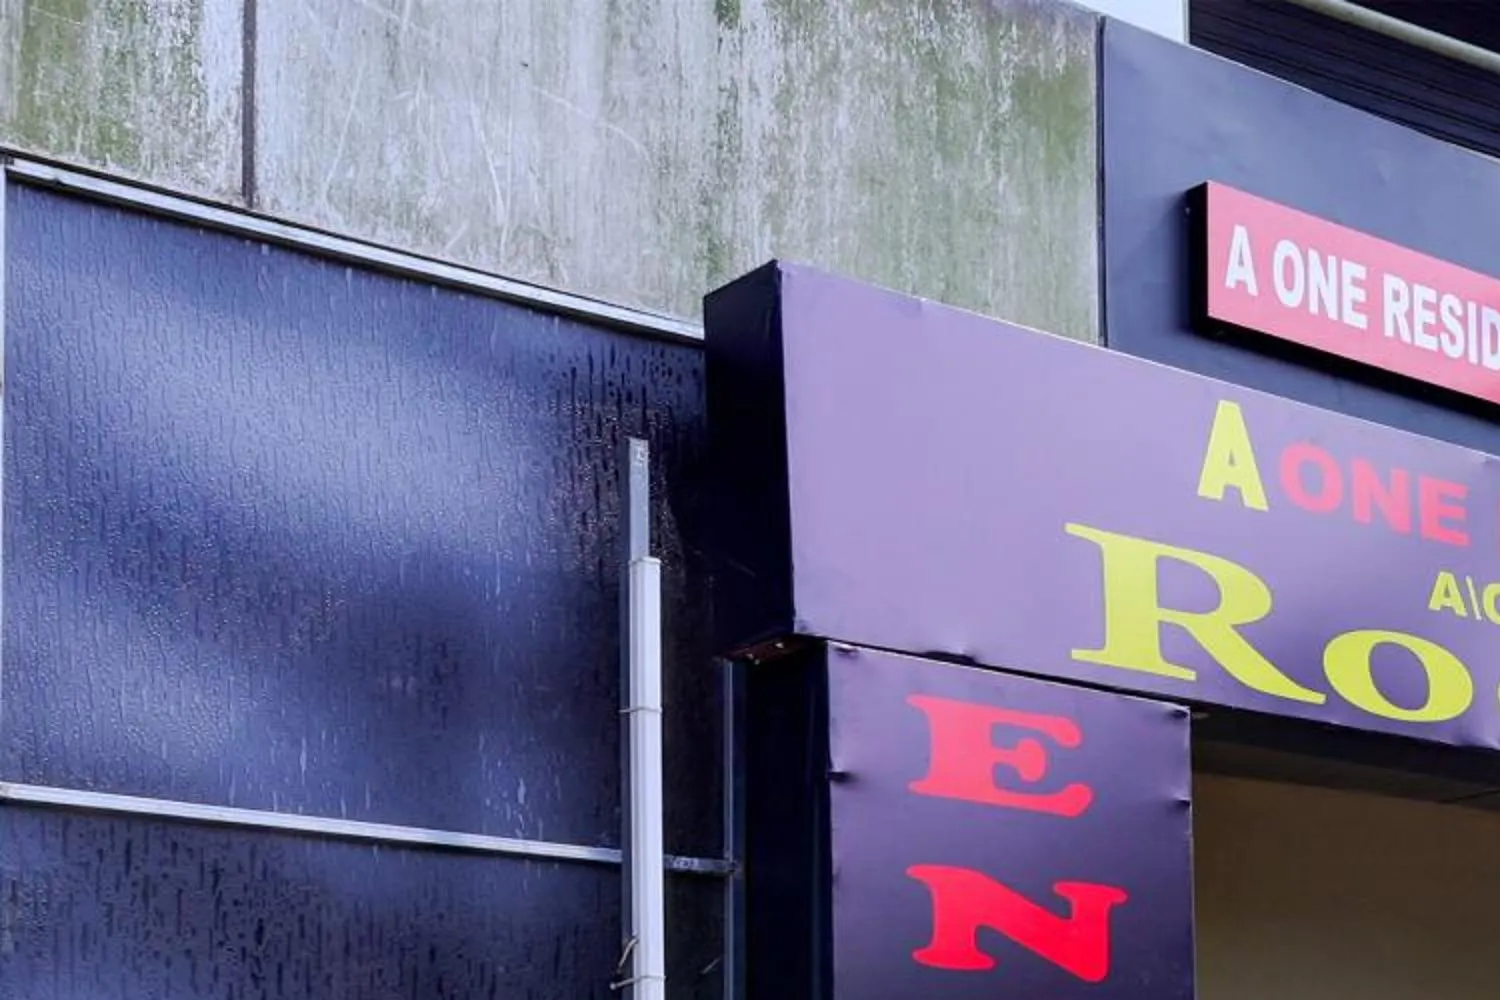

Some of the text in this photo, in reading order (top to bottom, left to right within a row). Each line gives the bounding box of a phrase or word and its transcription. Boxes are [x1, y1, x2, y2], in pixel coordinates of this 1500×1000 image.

[1225, 224, 1258, 298] A
[1272, 242, 1368, 330] ONE
[1198, 399, 1269, 511] A
[1278, 441, 1471, 548] ONE
